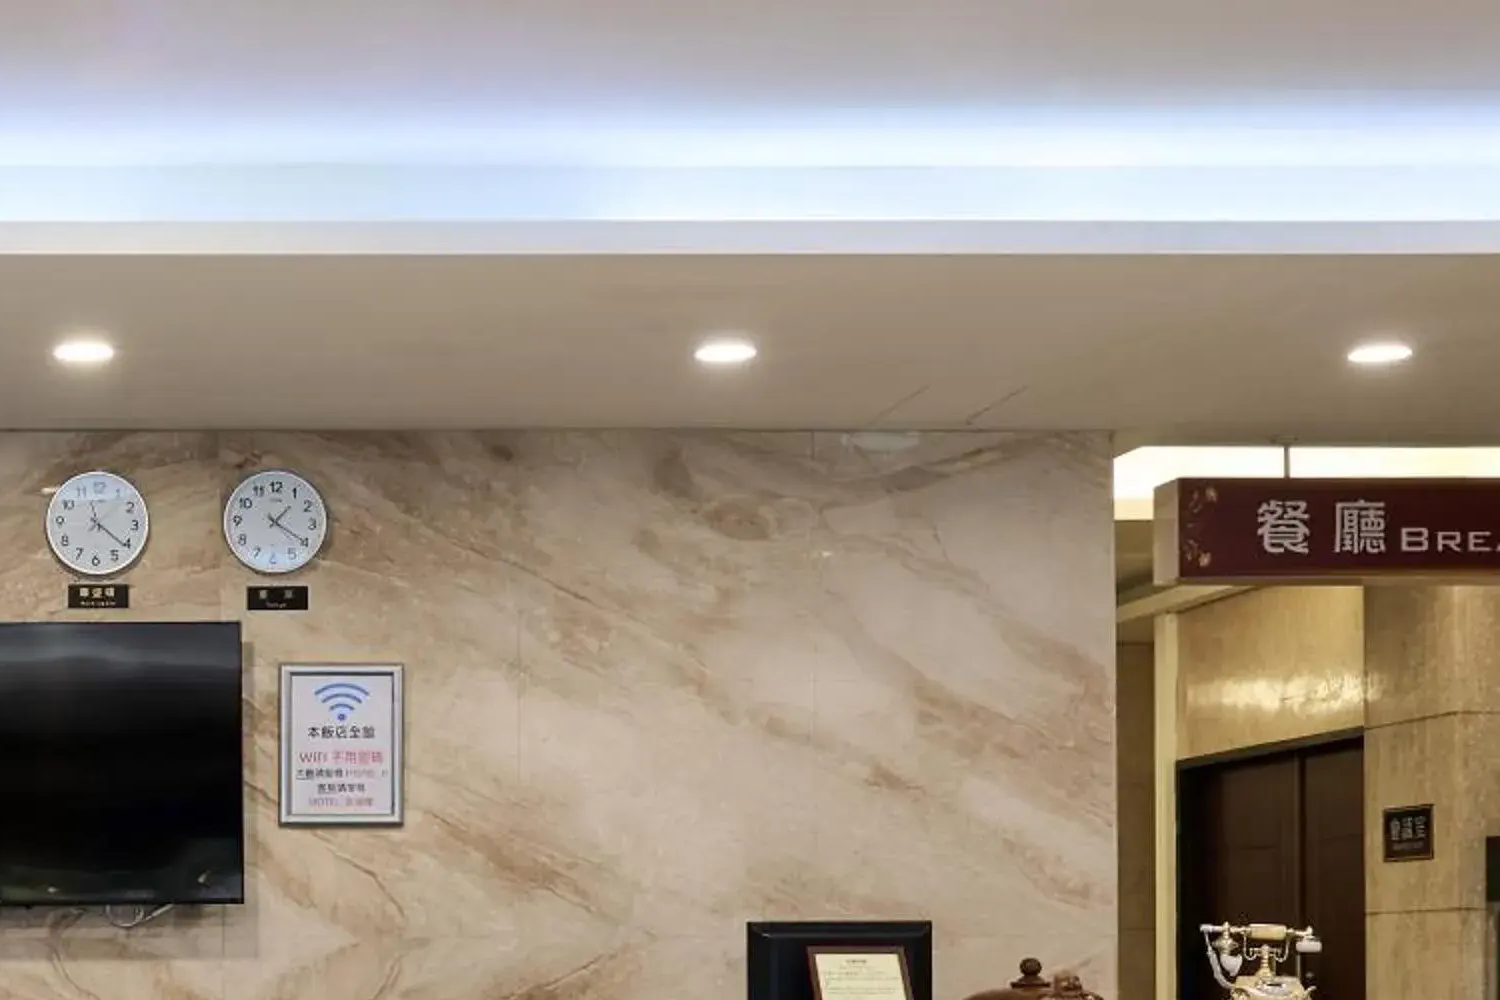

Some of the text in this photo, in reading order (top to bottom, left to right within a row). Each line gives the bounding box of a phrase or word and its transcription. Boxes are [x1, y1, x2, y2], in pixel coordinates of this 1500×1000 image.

[77, 486, 86, 497] 11
[93, 482, 106, 494] 12
[253, 485, 264, 497] 11
[270, 481, 283, 493] 12
[63, 500, 75, 510] 10
[126, 501, 134, 513] 2
[239, 498, 253, 509] 10
[303, 500, 313, 513] 2
[56, 515, 64, 527] 9
[131, 520, 139, 531] 3
[233, 515, 243, 527] 9
[308, 518, 316, 530] 3
[1257, 499, 1500, 553] 餐廳 BRE
[61, 535, 69, 546] 8
[123, 538, 131, 549] 4
[238, 534, 247, 546] 8
[301, 537, 309, 547] 4
[75, 547, 84, 560] 7
[110, 549, 119, 561] 5
[254, 547, 261, 558] 7
[287, 547, 296, 560] 5
[92, 556, 100, 566] 6
